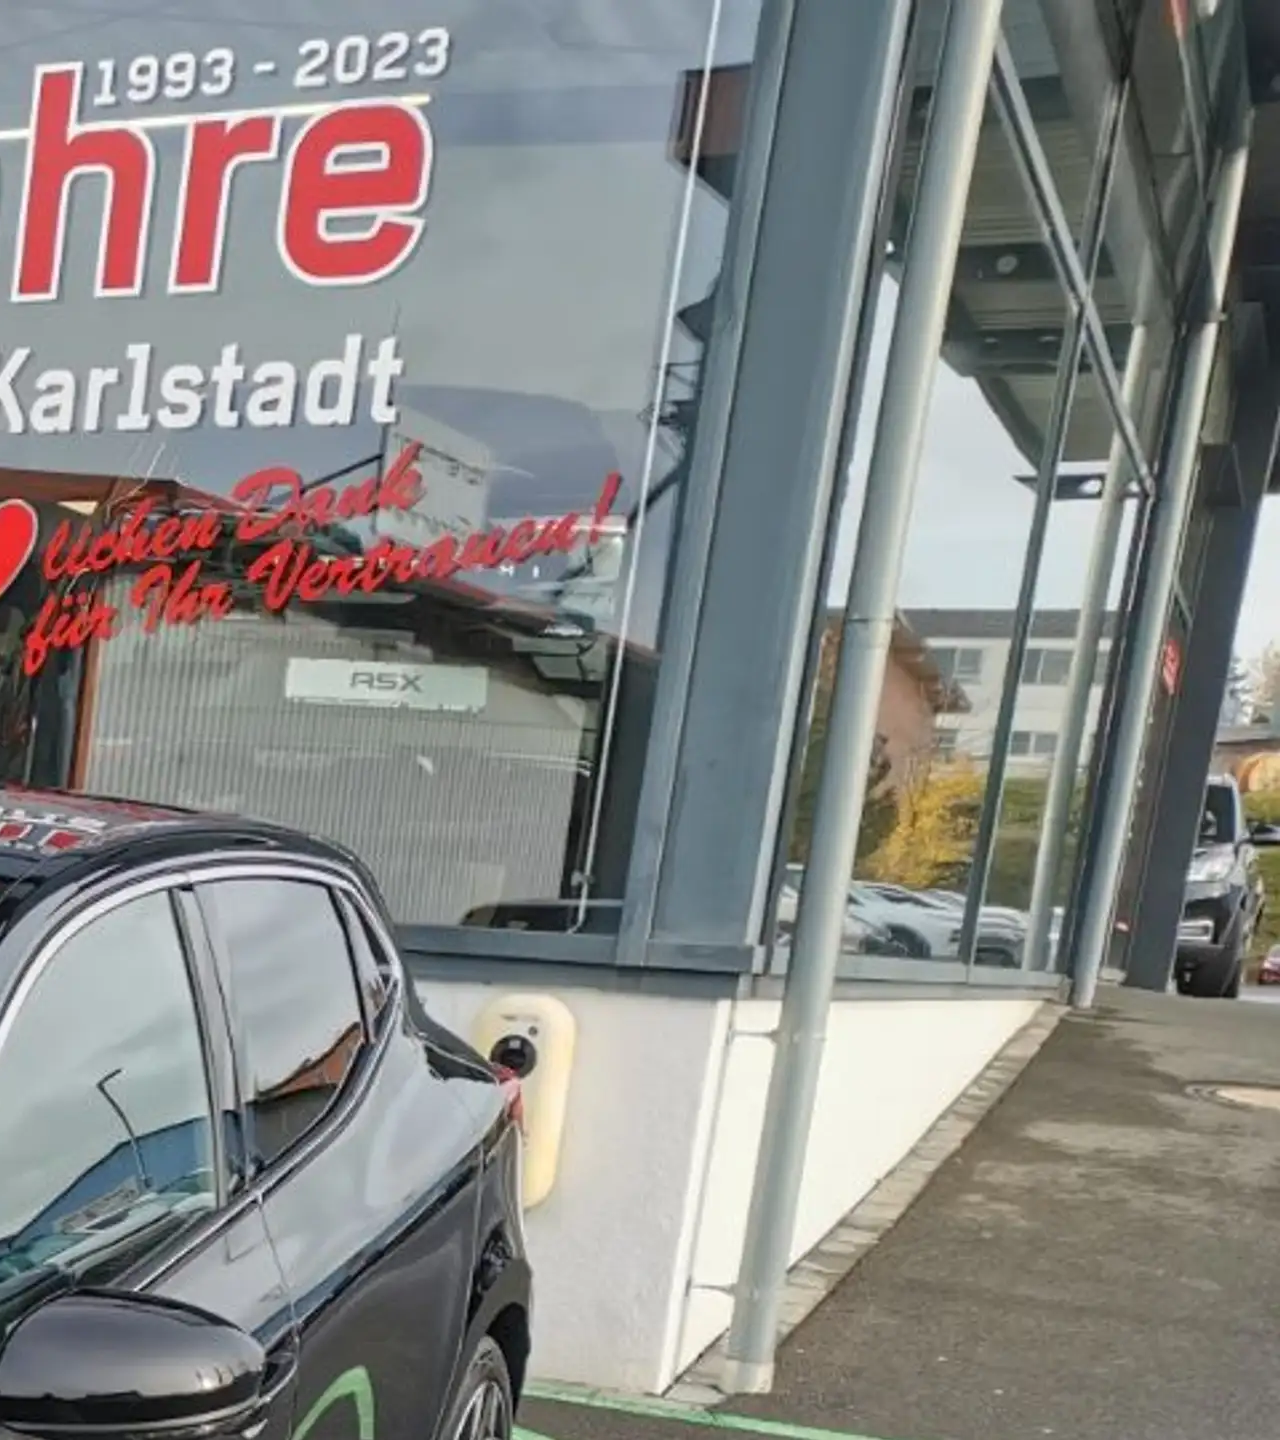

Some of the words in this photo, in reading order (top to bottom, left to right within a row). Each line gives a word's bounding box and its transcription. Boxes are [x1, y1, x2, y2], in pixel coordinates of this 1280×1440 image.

[93, 48, 234, 107] 1993
[294, 28, 450, 88] 2023
[42, 496, 221, 581] lichen
[232, 441, 427, 540] Dank
[23, 590, 121, 677] für
[131, 561, 235, 633] Ihr
[248, 473, 622, 611] Vertrauen!
[350, 671, 425, 693] ASX
